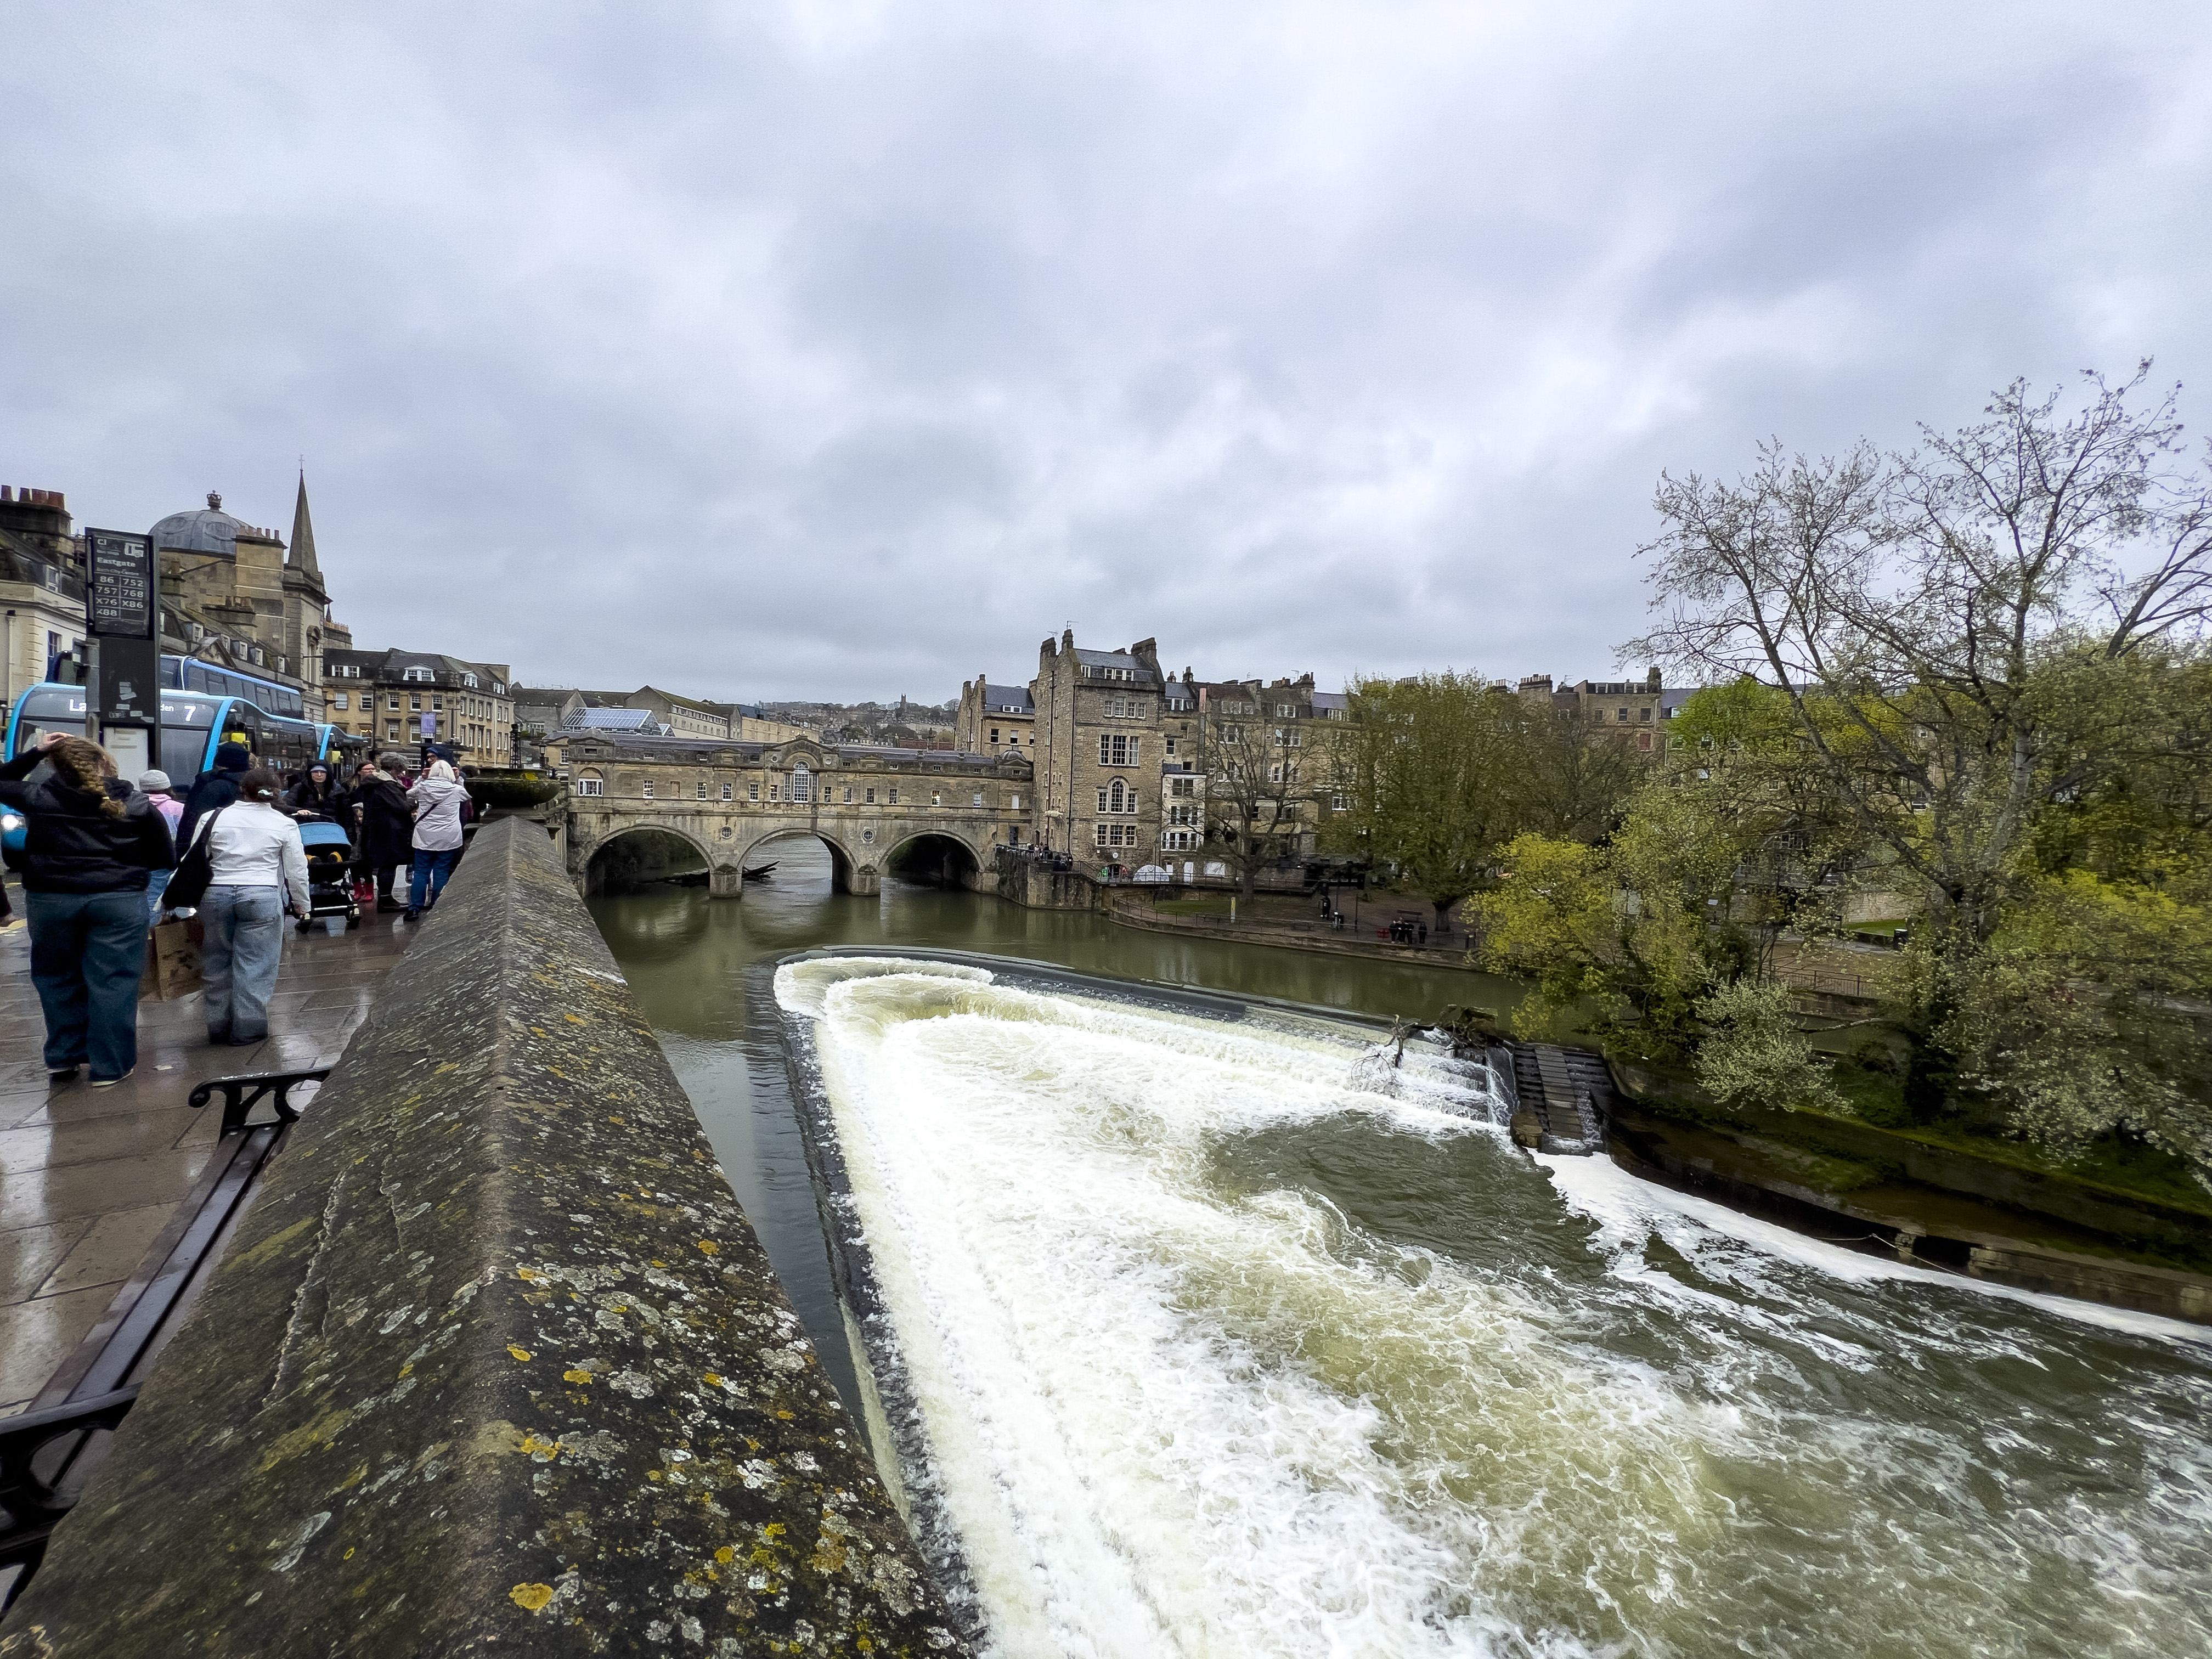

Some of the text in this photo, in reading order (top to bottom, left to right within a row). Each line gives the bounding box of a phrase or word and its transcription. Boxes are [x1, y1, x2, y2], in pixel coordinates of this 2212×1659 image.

[97, 557, 136, 567] Eastgate
[122, 578, 144, 587] 752
[95, 586, 143, 597] 757 768
[95, 597, 143, 608] X76 X86
[69, 698, 196, 722] La den 7
